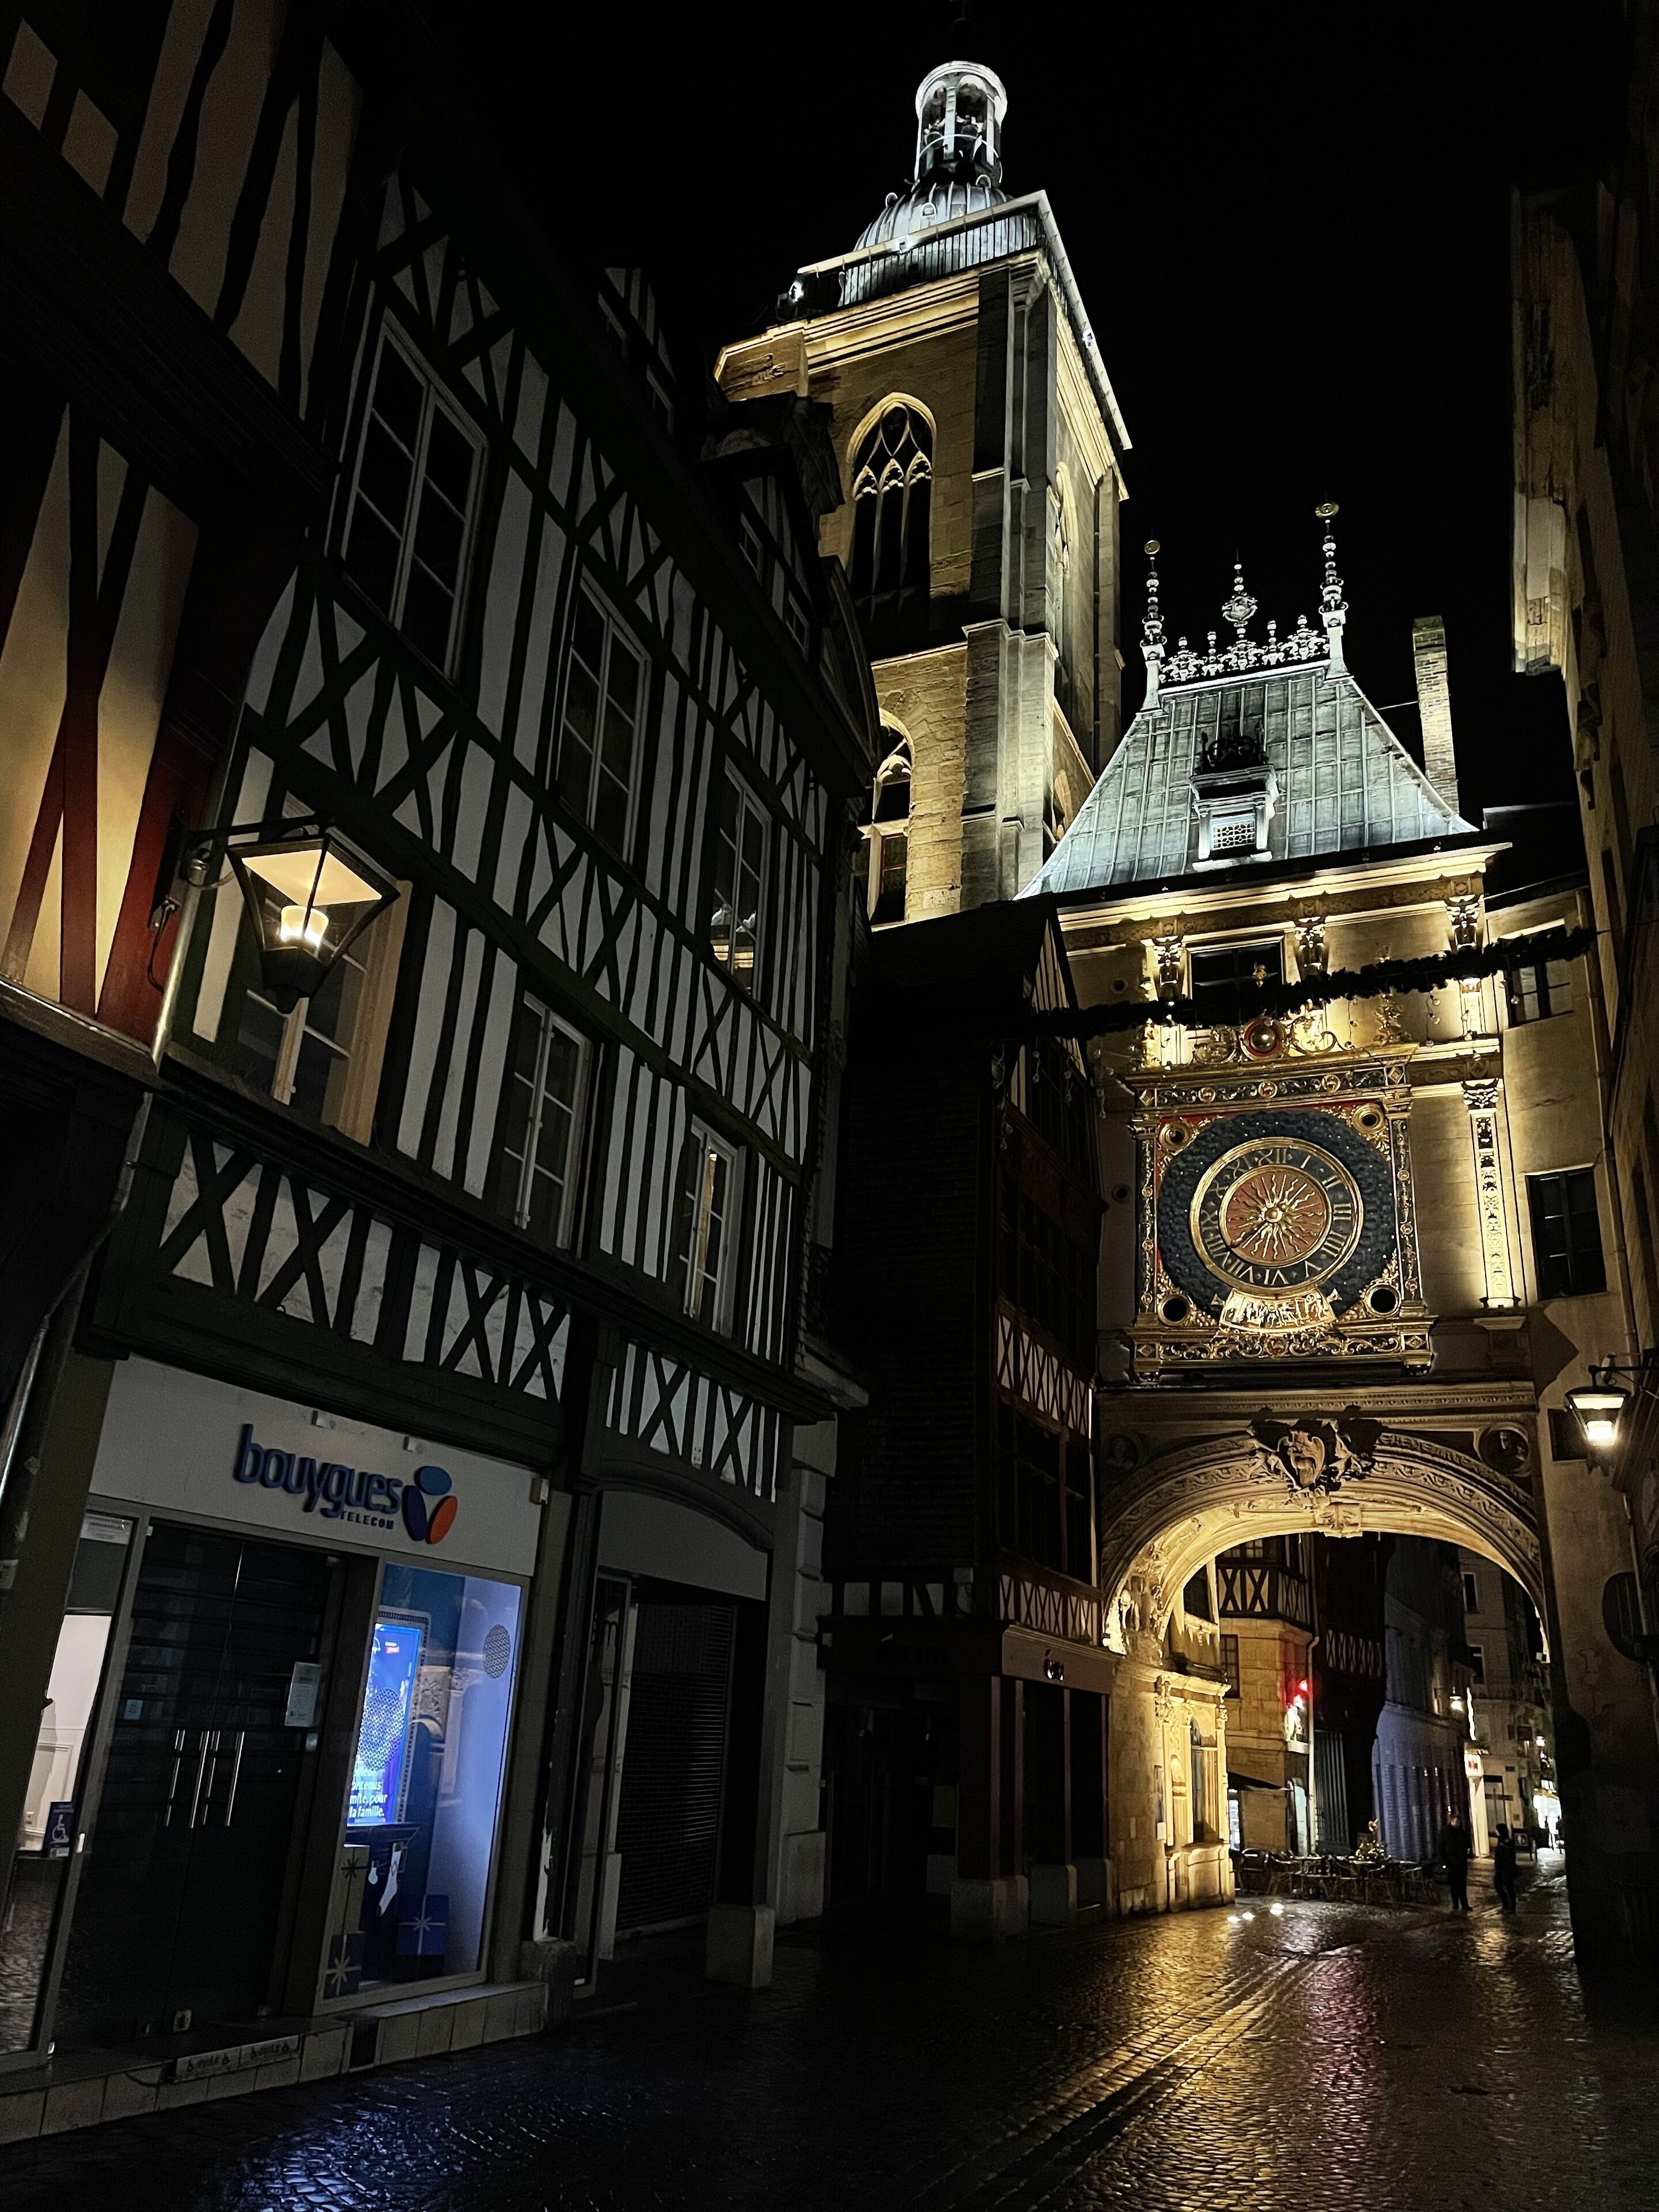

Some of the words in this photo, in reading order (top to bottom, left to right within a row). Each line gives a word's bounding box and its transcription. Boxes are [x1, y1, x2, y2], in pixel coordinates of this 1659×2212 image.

[1257, 1148, 1287, 1166] XII
[1300, 1154, 1312, 1169] I
[1226, 1156, 1252, 1180] XI
[1321, 1175, 1342, 1191] II
[1332, 1203, 1352, 1221] III
[1320, 1230, 1347, 1257] IIII
[1227, 1259, 1255, 1284] VII
[1263, 1267, 1290, 1286] VI
[1304, 1260, 1323, 1278] V
[233, 1423, 403, 1518] bouygues
[339, 1510, 395, 1530] TELECOM
[369, 1794, 388, 1806] pour
[357, 1805, 385, 1817] famille.
